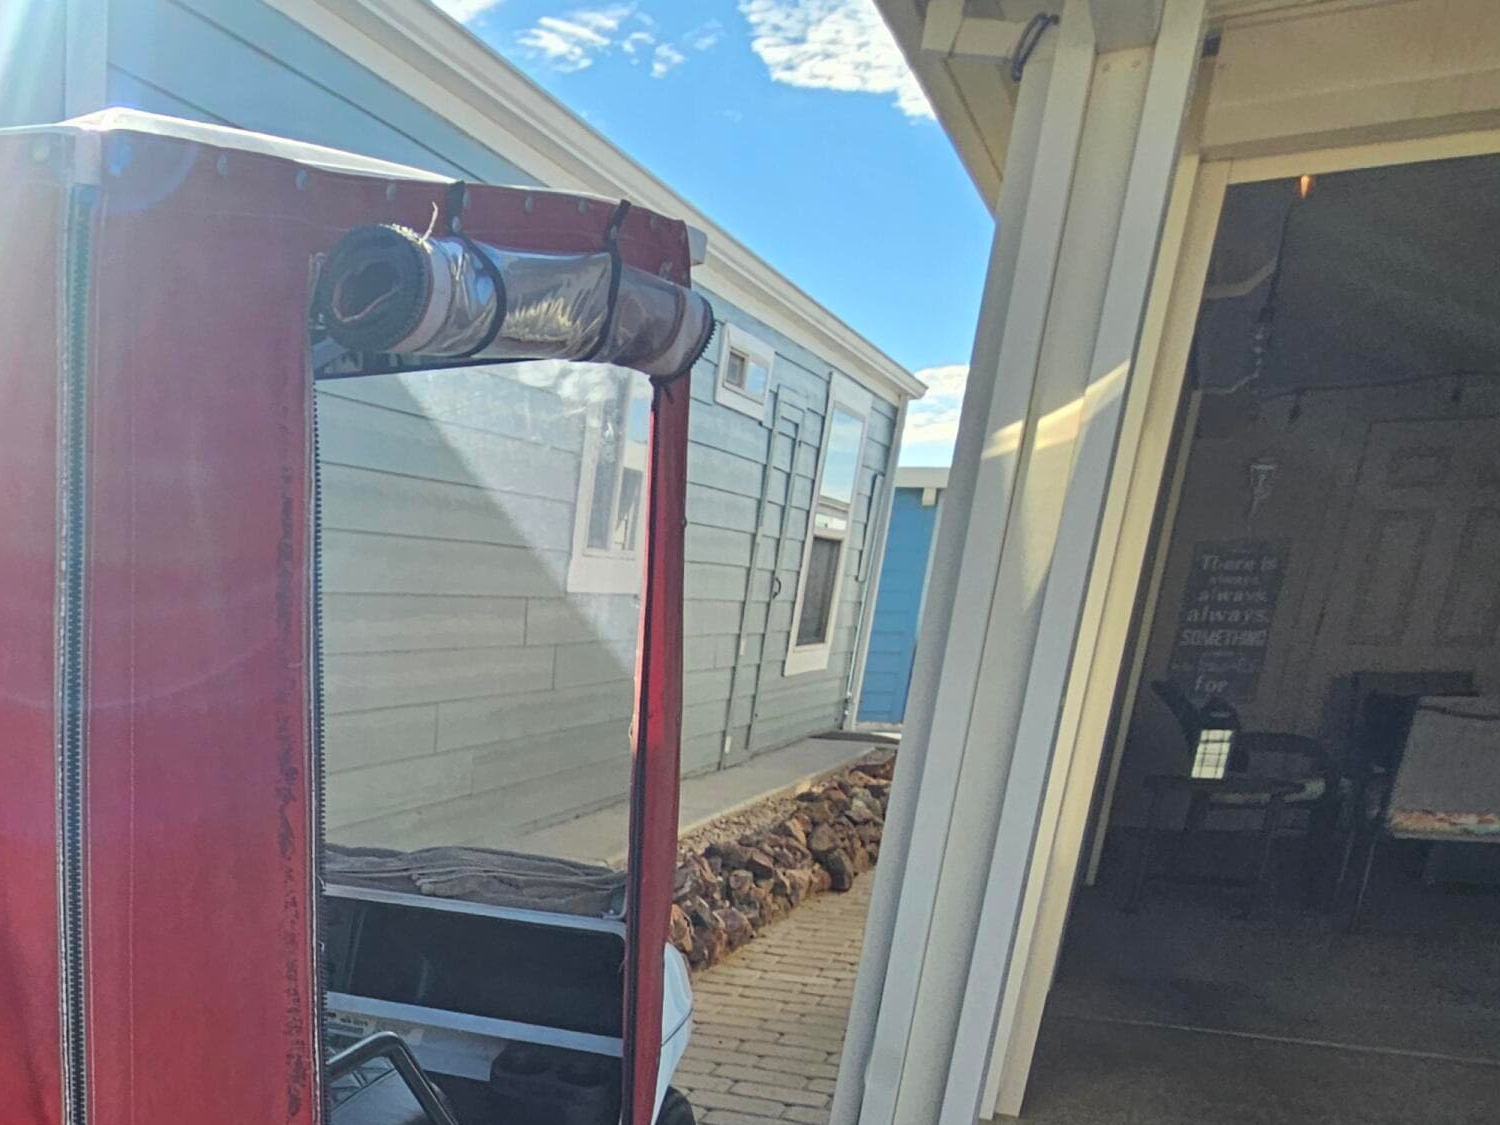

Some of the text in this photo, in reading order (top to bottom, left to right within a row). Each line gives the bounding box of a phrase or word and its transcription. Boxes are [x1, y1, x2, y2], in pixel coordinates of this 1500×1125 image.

[1201, 554, 1255, 572] There
[1179, 628, 1268, 647] SOMETHING
[1194, 675, 1229, 693] for
